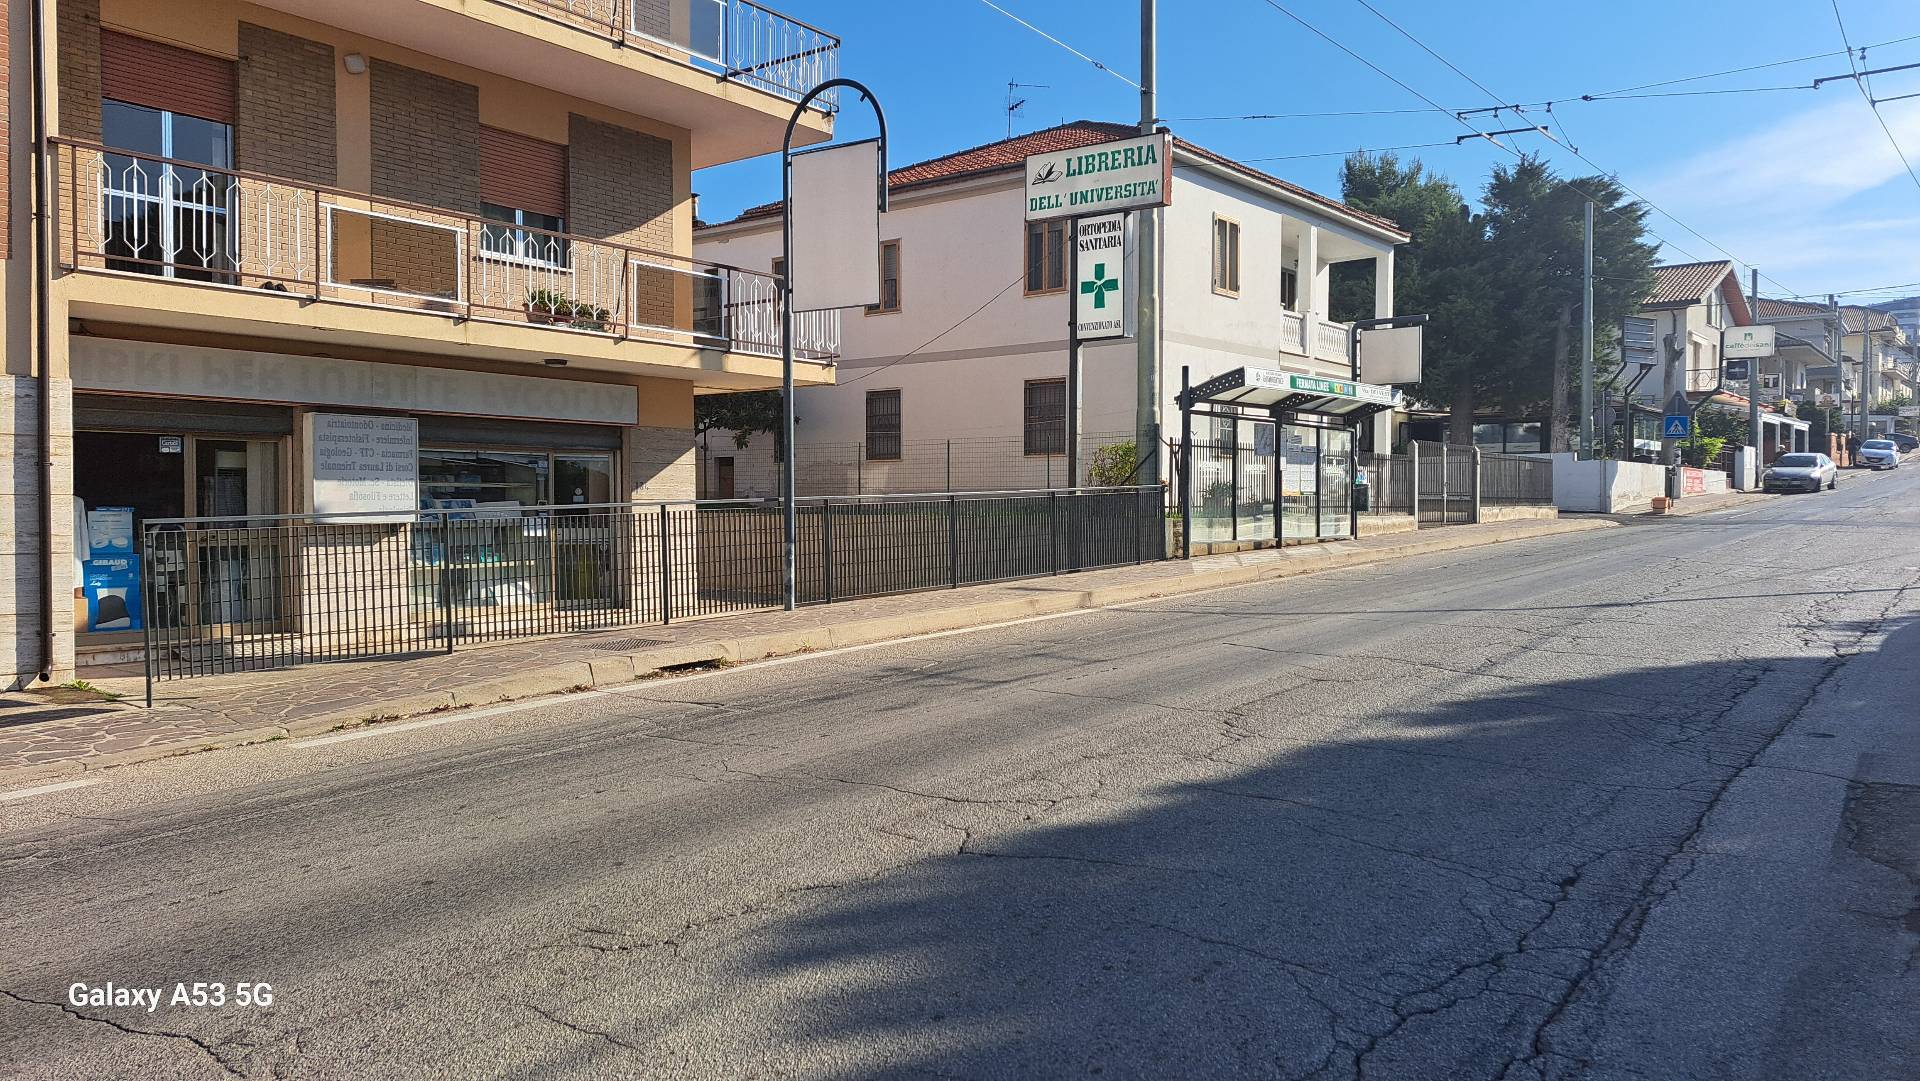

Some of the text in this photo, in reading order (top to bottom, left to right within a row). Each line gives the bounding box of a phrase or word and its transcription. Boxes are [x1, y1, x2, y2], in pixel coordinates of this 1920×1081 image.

[1065, 143, 1158, 178] LIBRERIA
[1079, 219, 1122, 237] ORTOPEDIA
[1079, 234, 1122, 252] SANITARIA
